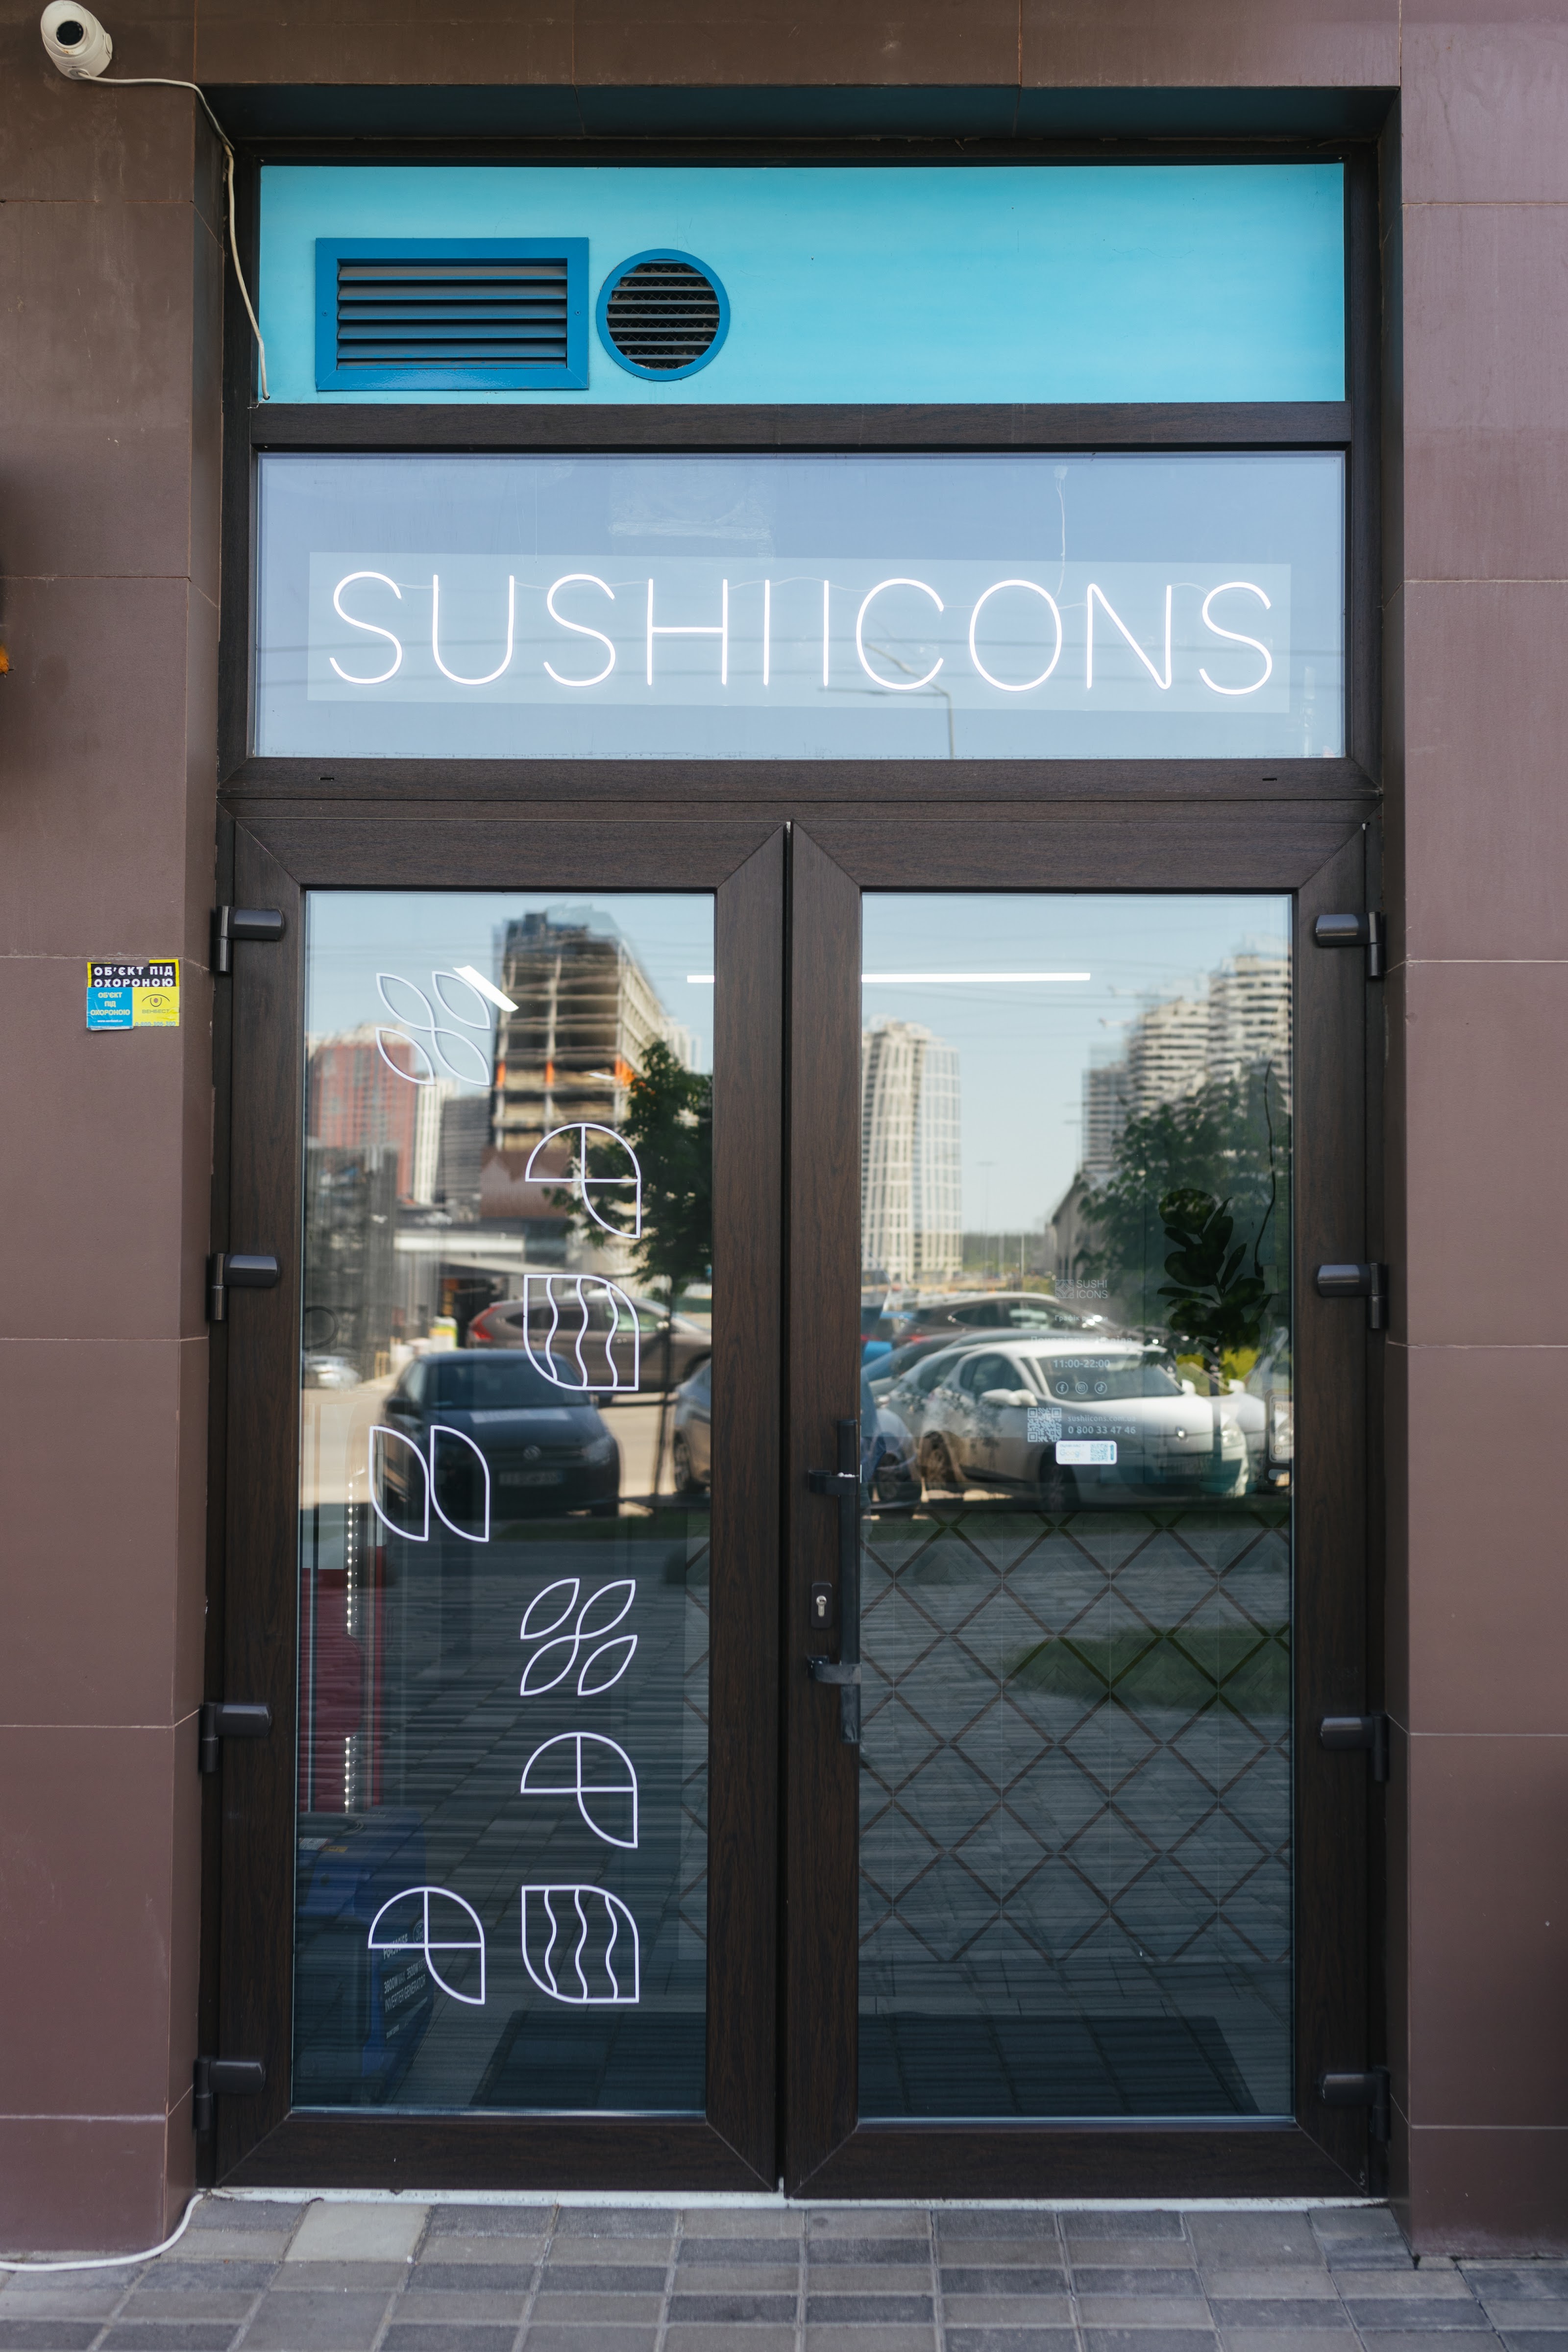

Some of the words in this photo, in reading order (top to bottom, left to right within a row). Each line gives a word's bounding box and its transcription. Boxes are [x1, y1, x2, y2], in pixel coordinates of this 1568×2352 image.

[329, 571, 770, 686] SUSHI
[823, 578, 1273, 695] ICONS
[94, 966, 144, 976] ОБ'ЄКТ
[149, 966, 173, 977] ПІД
[94, 979, 174, 987] ОХОРОНОЮ
[1076, 1279, 1107, 1288] SUSHI
[1076, 1290, 1108, 1298] ICONS
[1054, 1314, 1080, 1323] Графік
[1053, 1359, 1110, 1369] 11:00-22:00
[384, 1974, 398, 1994] 3800W
[385, 1988, 404, 2013] INVERTER
[404, 1974, 426, 1999] GENERATOR
